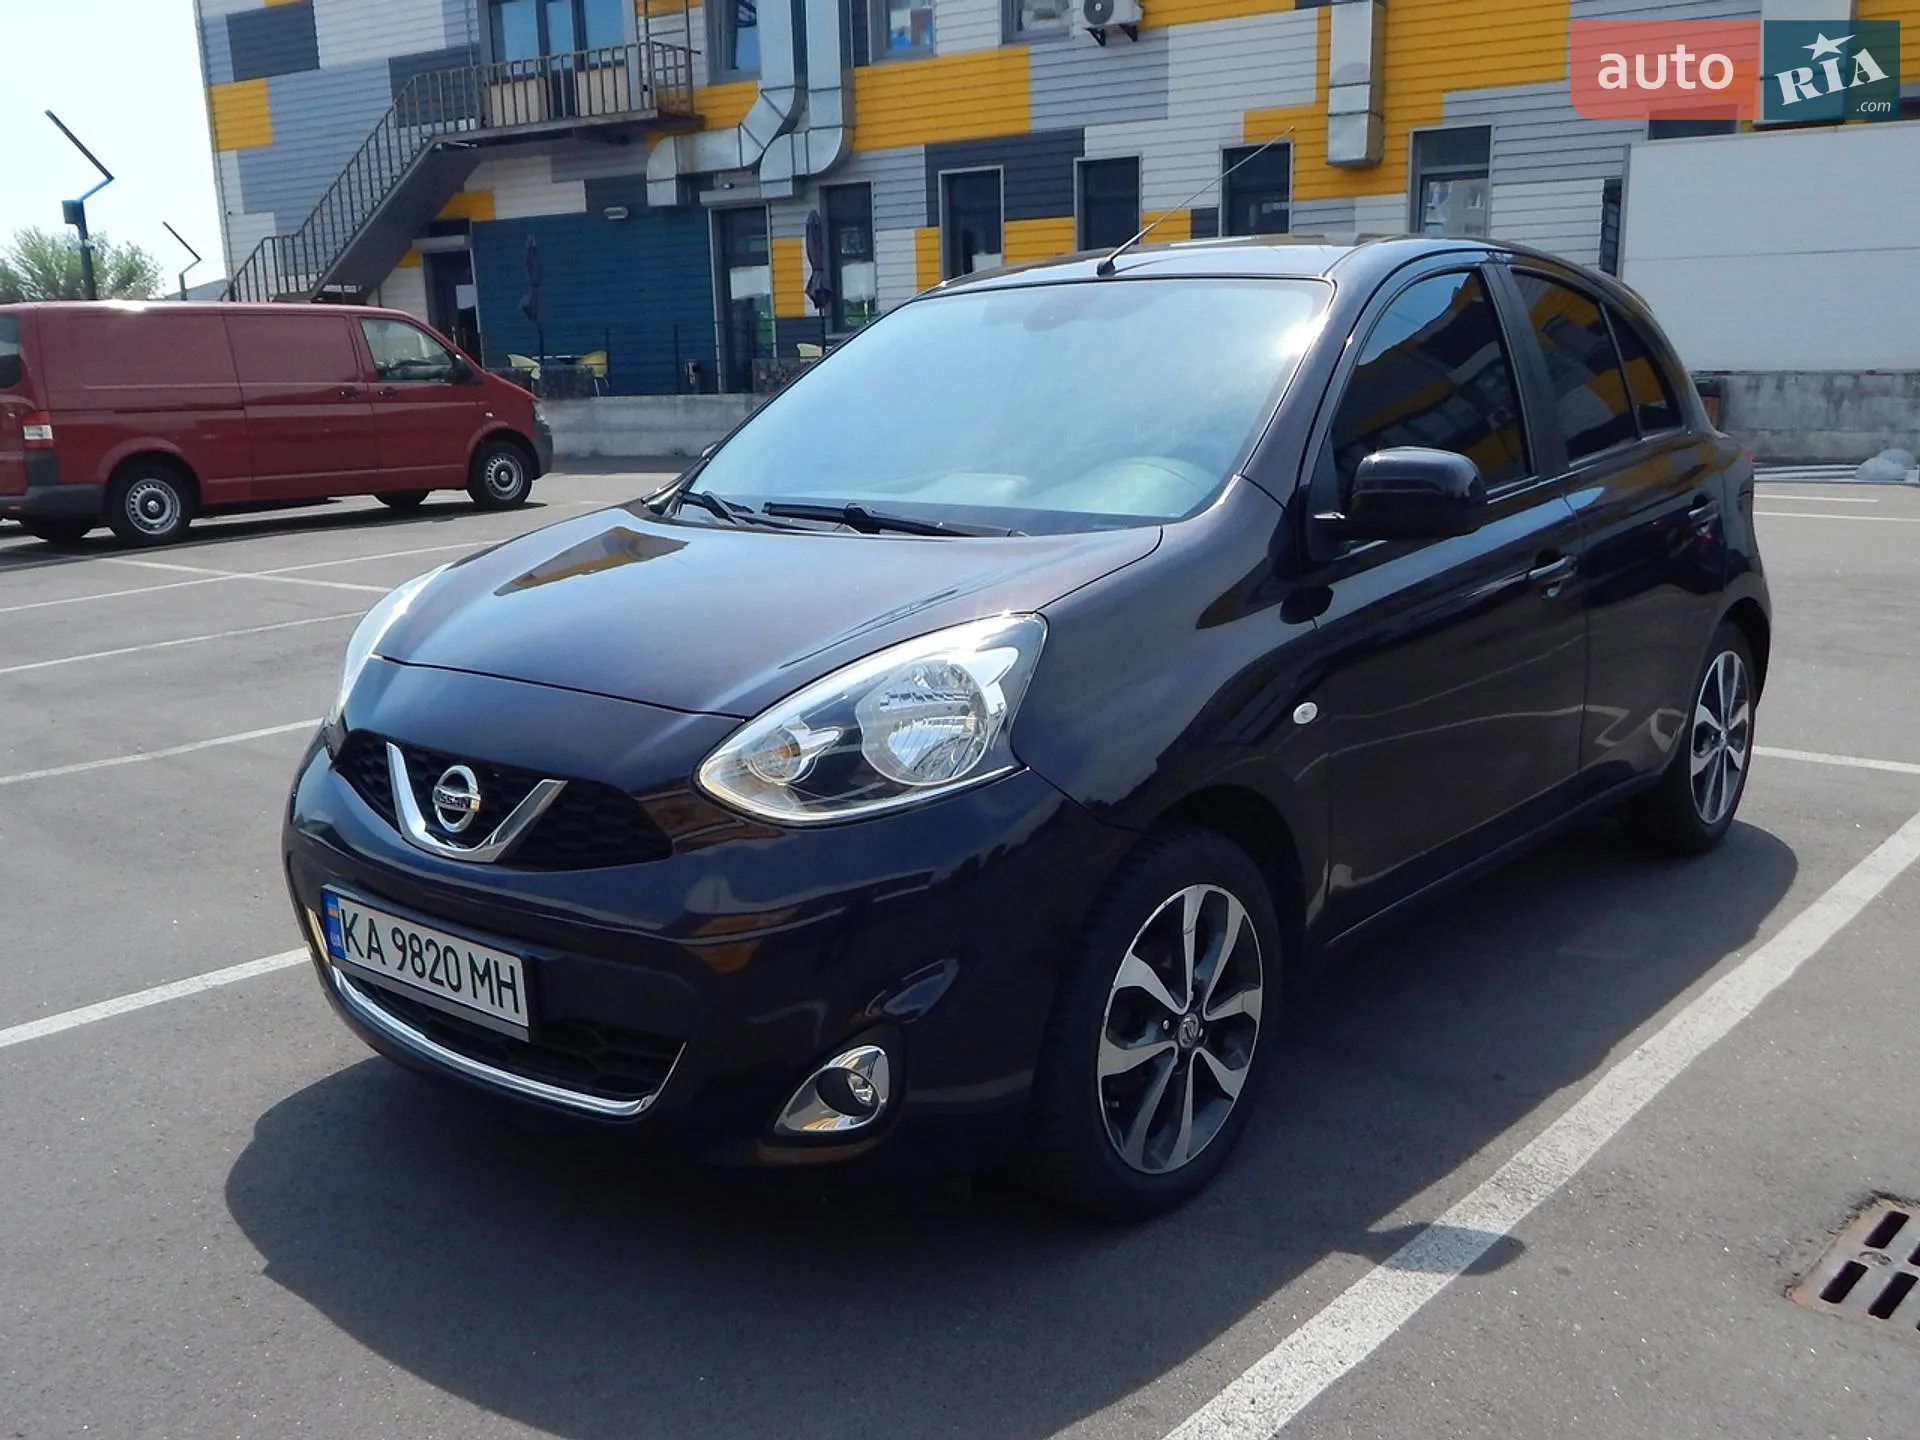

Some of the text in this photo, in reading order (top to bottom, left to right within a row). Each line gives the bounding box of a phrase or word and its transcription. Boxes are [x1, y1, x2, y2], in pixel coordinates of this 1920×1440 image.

[341, 908, 520, 1014] KA 9820 MH
